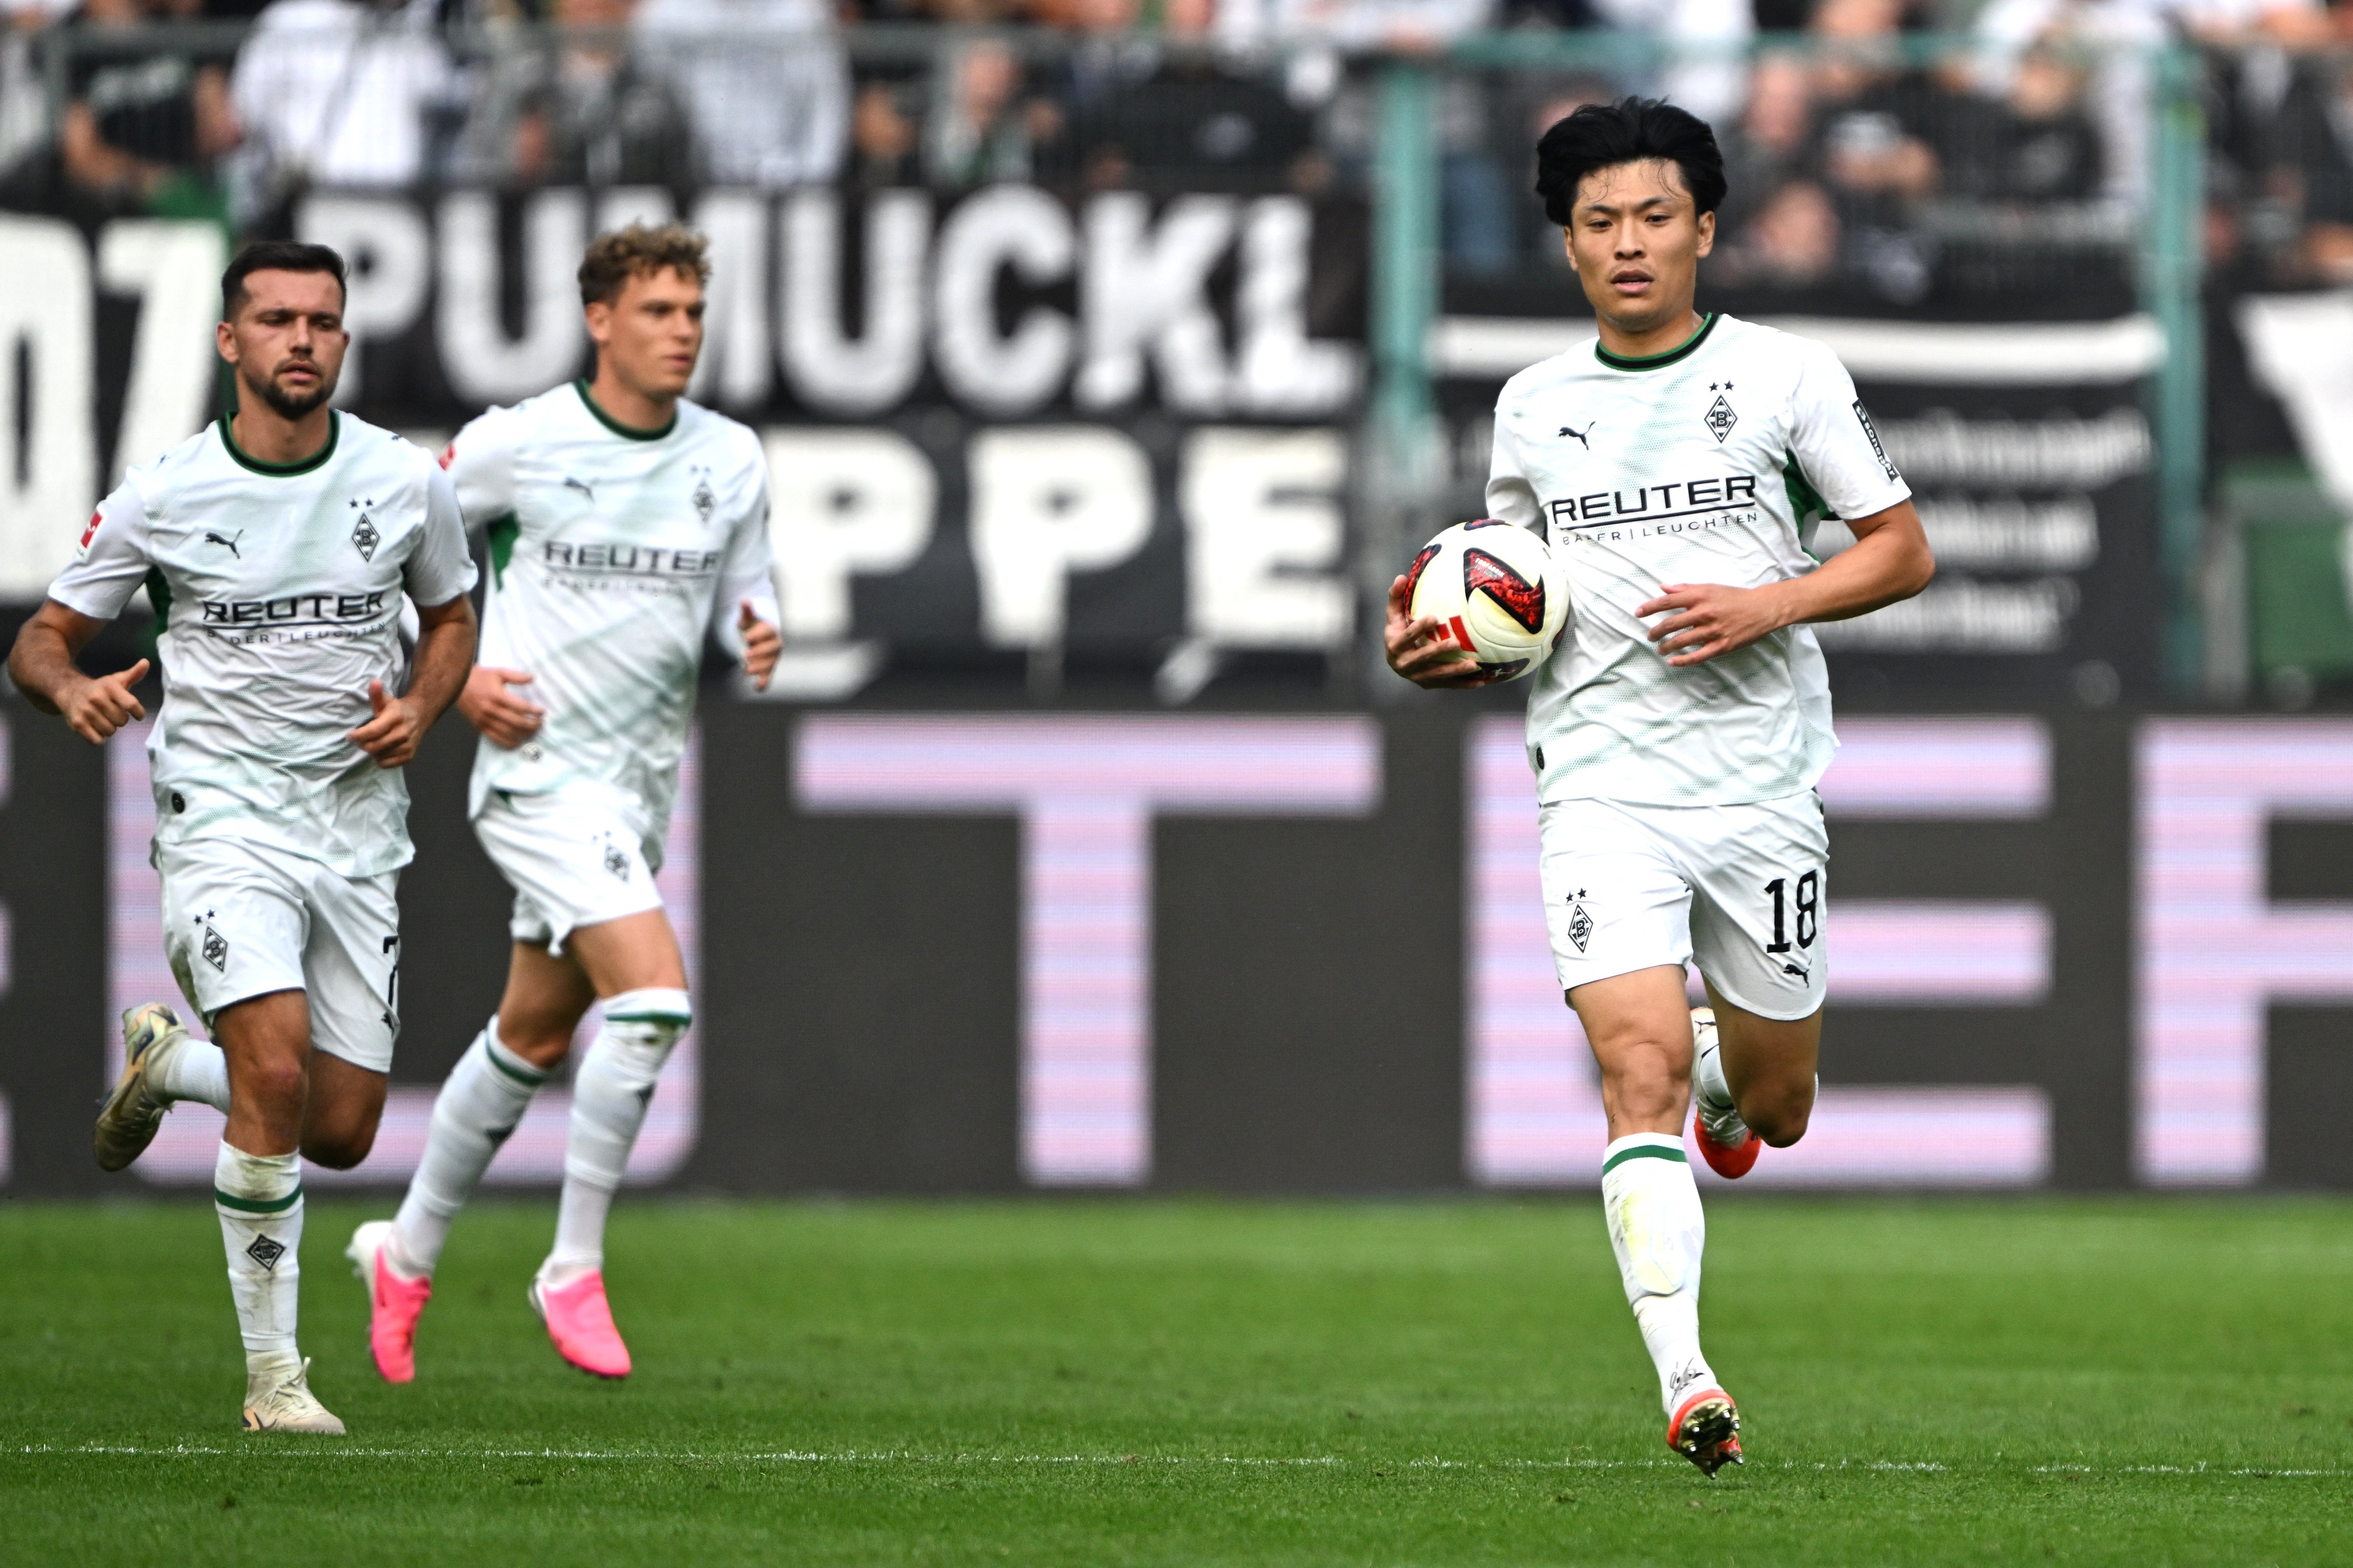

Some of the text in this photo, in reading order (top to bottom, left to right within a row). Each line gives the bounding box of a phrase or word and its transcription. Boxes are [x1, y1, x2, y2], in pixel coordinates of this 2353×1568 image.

[1552, 475, 1756, 525] REUTER
[202, 593, 383, 622] REUTER
[1764, 869, 1818, 953] 18
